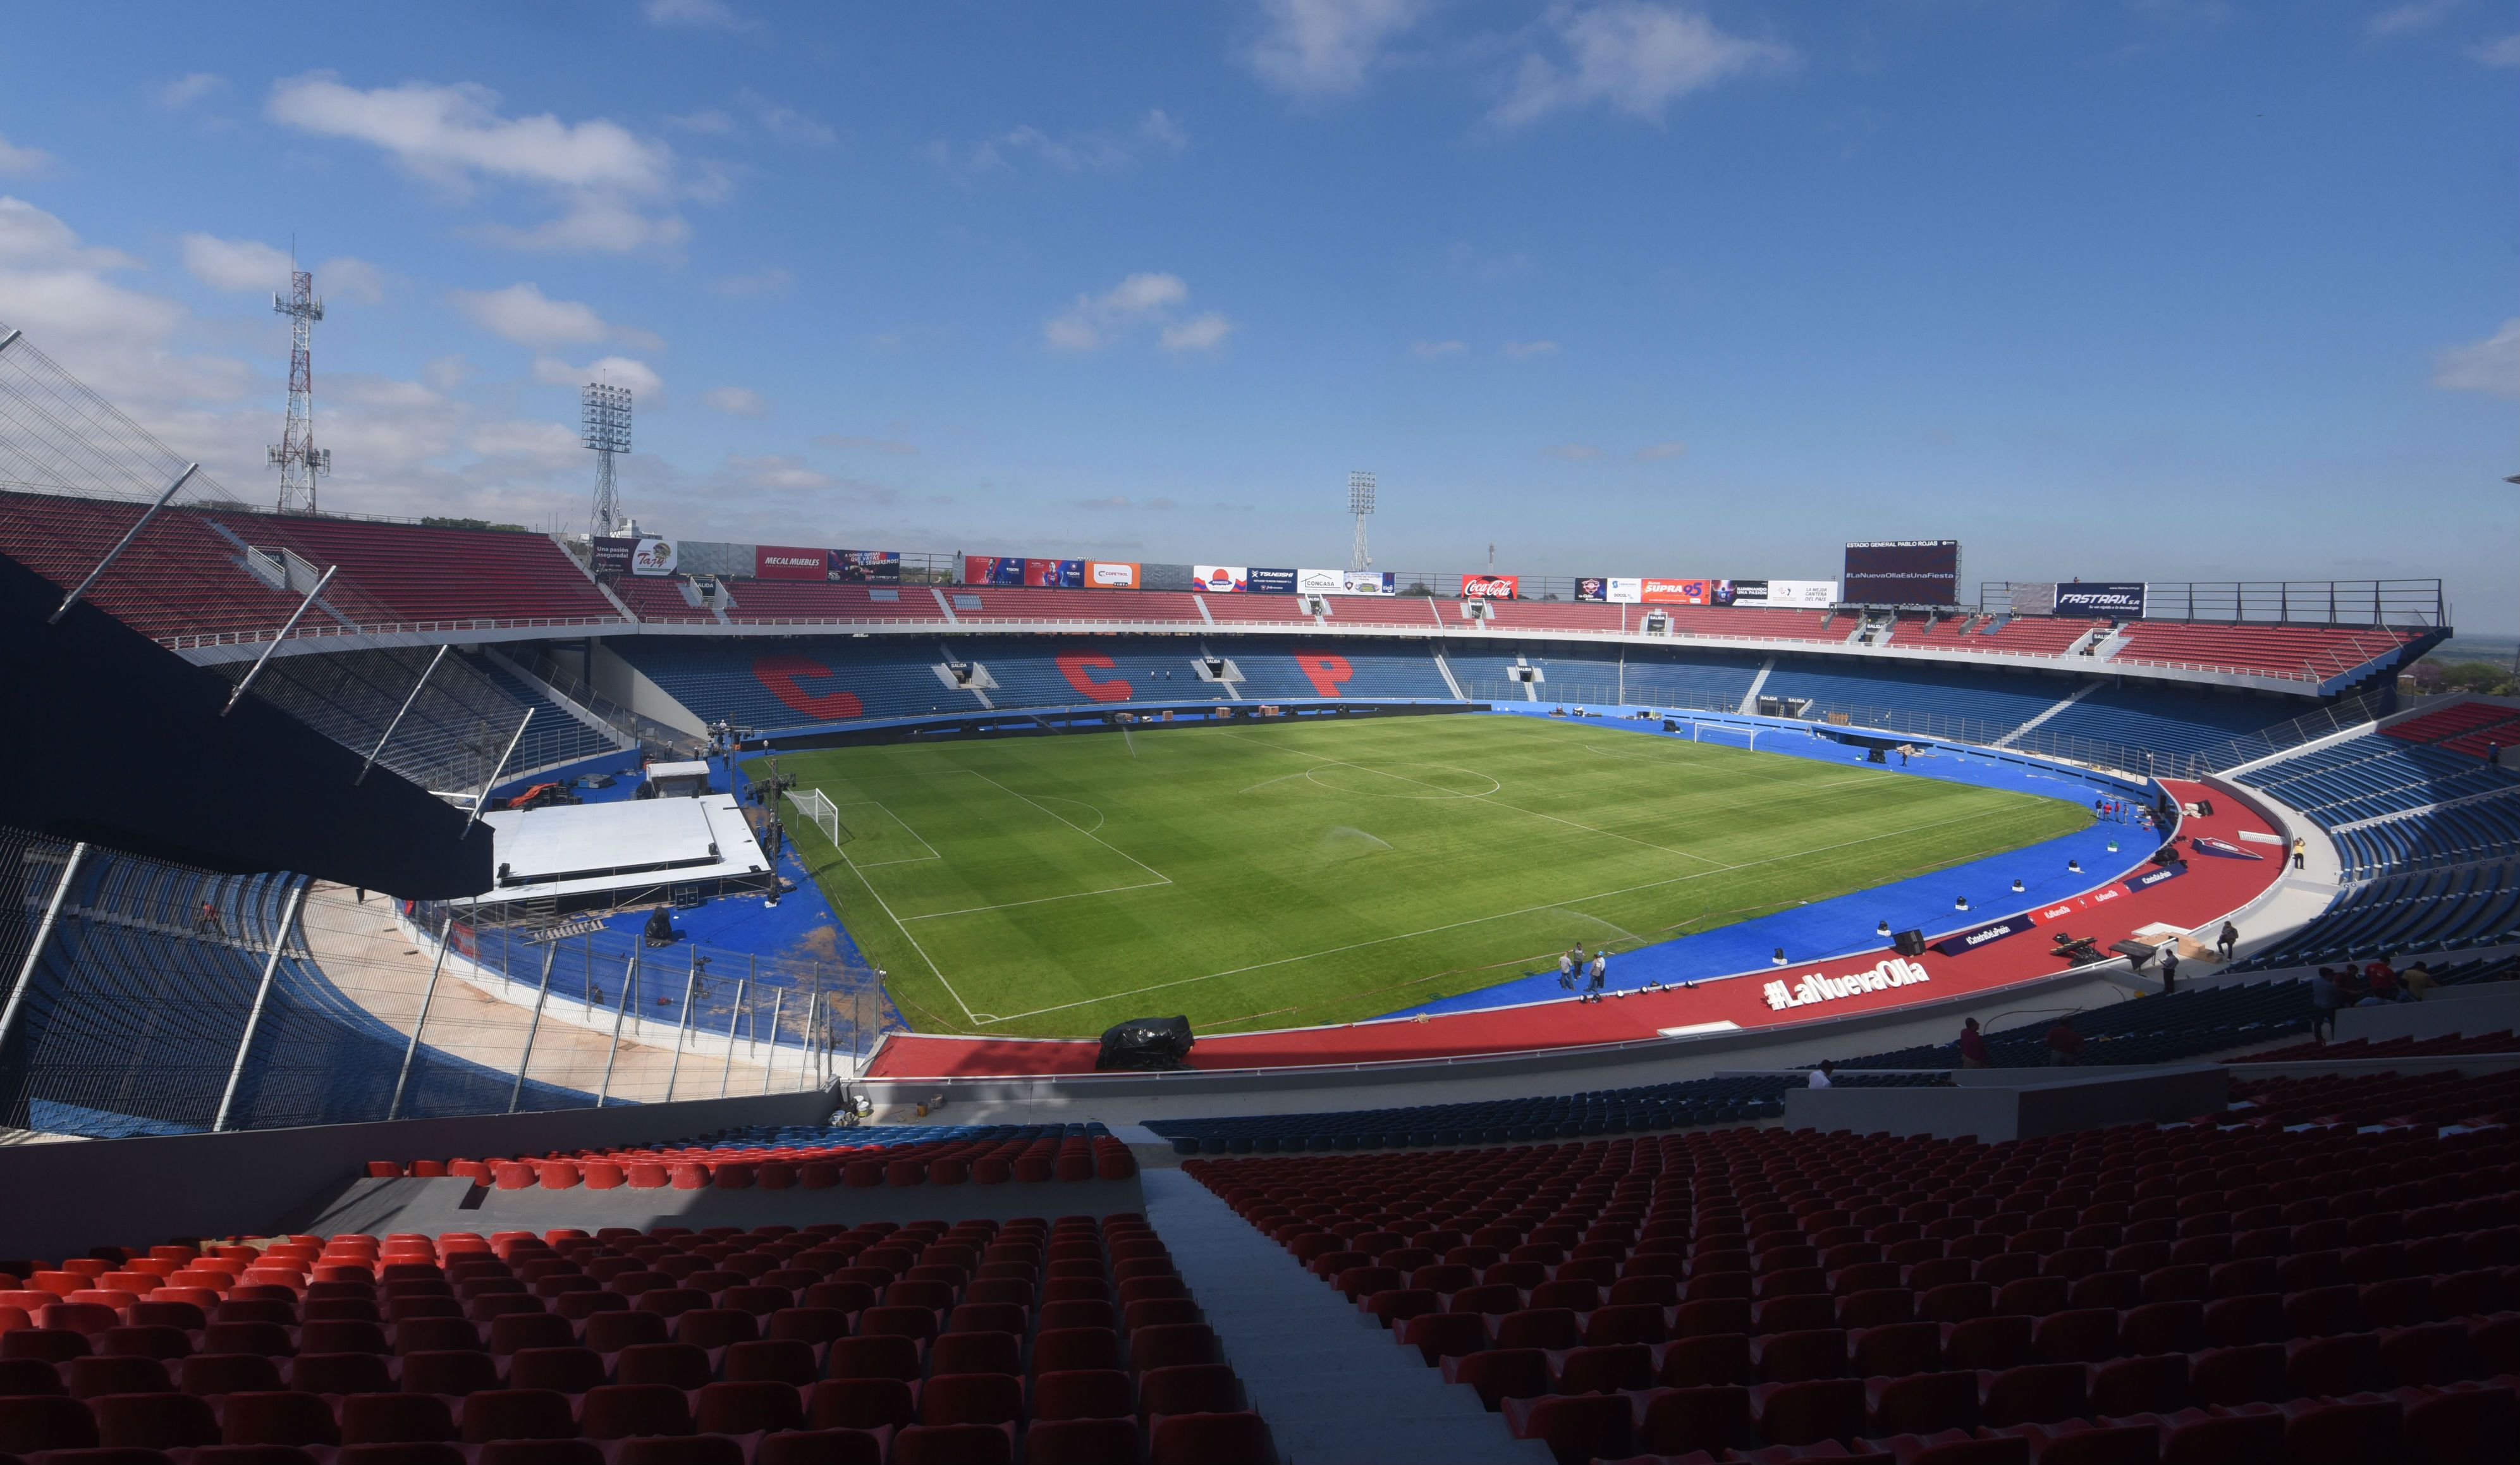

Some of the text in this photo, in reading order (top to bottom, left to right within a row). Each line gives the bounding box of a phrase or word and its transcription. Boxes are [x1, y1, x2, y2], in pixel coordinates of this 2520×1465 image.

[765, 556, 820, 567] MECAL MUEBLES
[1464, 580, 1514, 596] Coca-Cola
[1645, 585, 1682, 593] SUPRA
[1683, 582, 1703, 597] 95
[2059, 594, 2131, 604] FASTRAX
[1055, 649, 1133, 702] C
[1291, 648, 1355, 697] P
[1763, 957, 1931, 1012] #LaNuevaOlla
